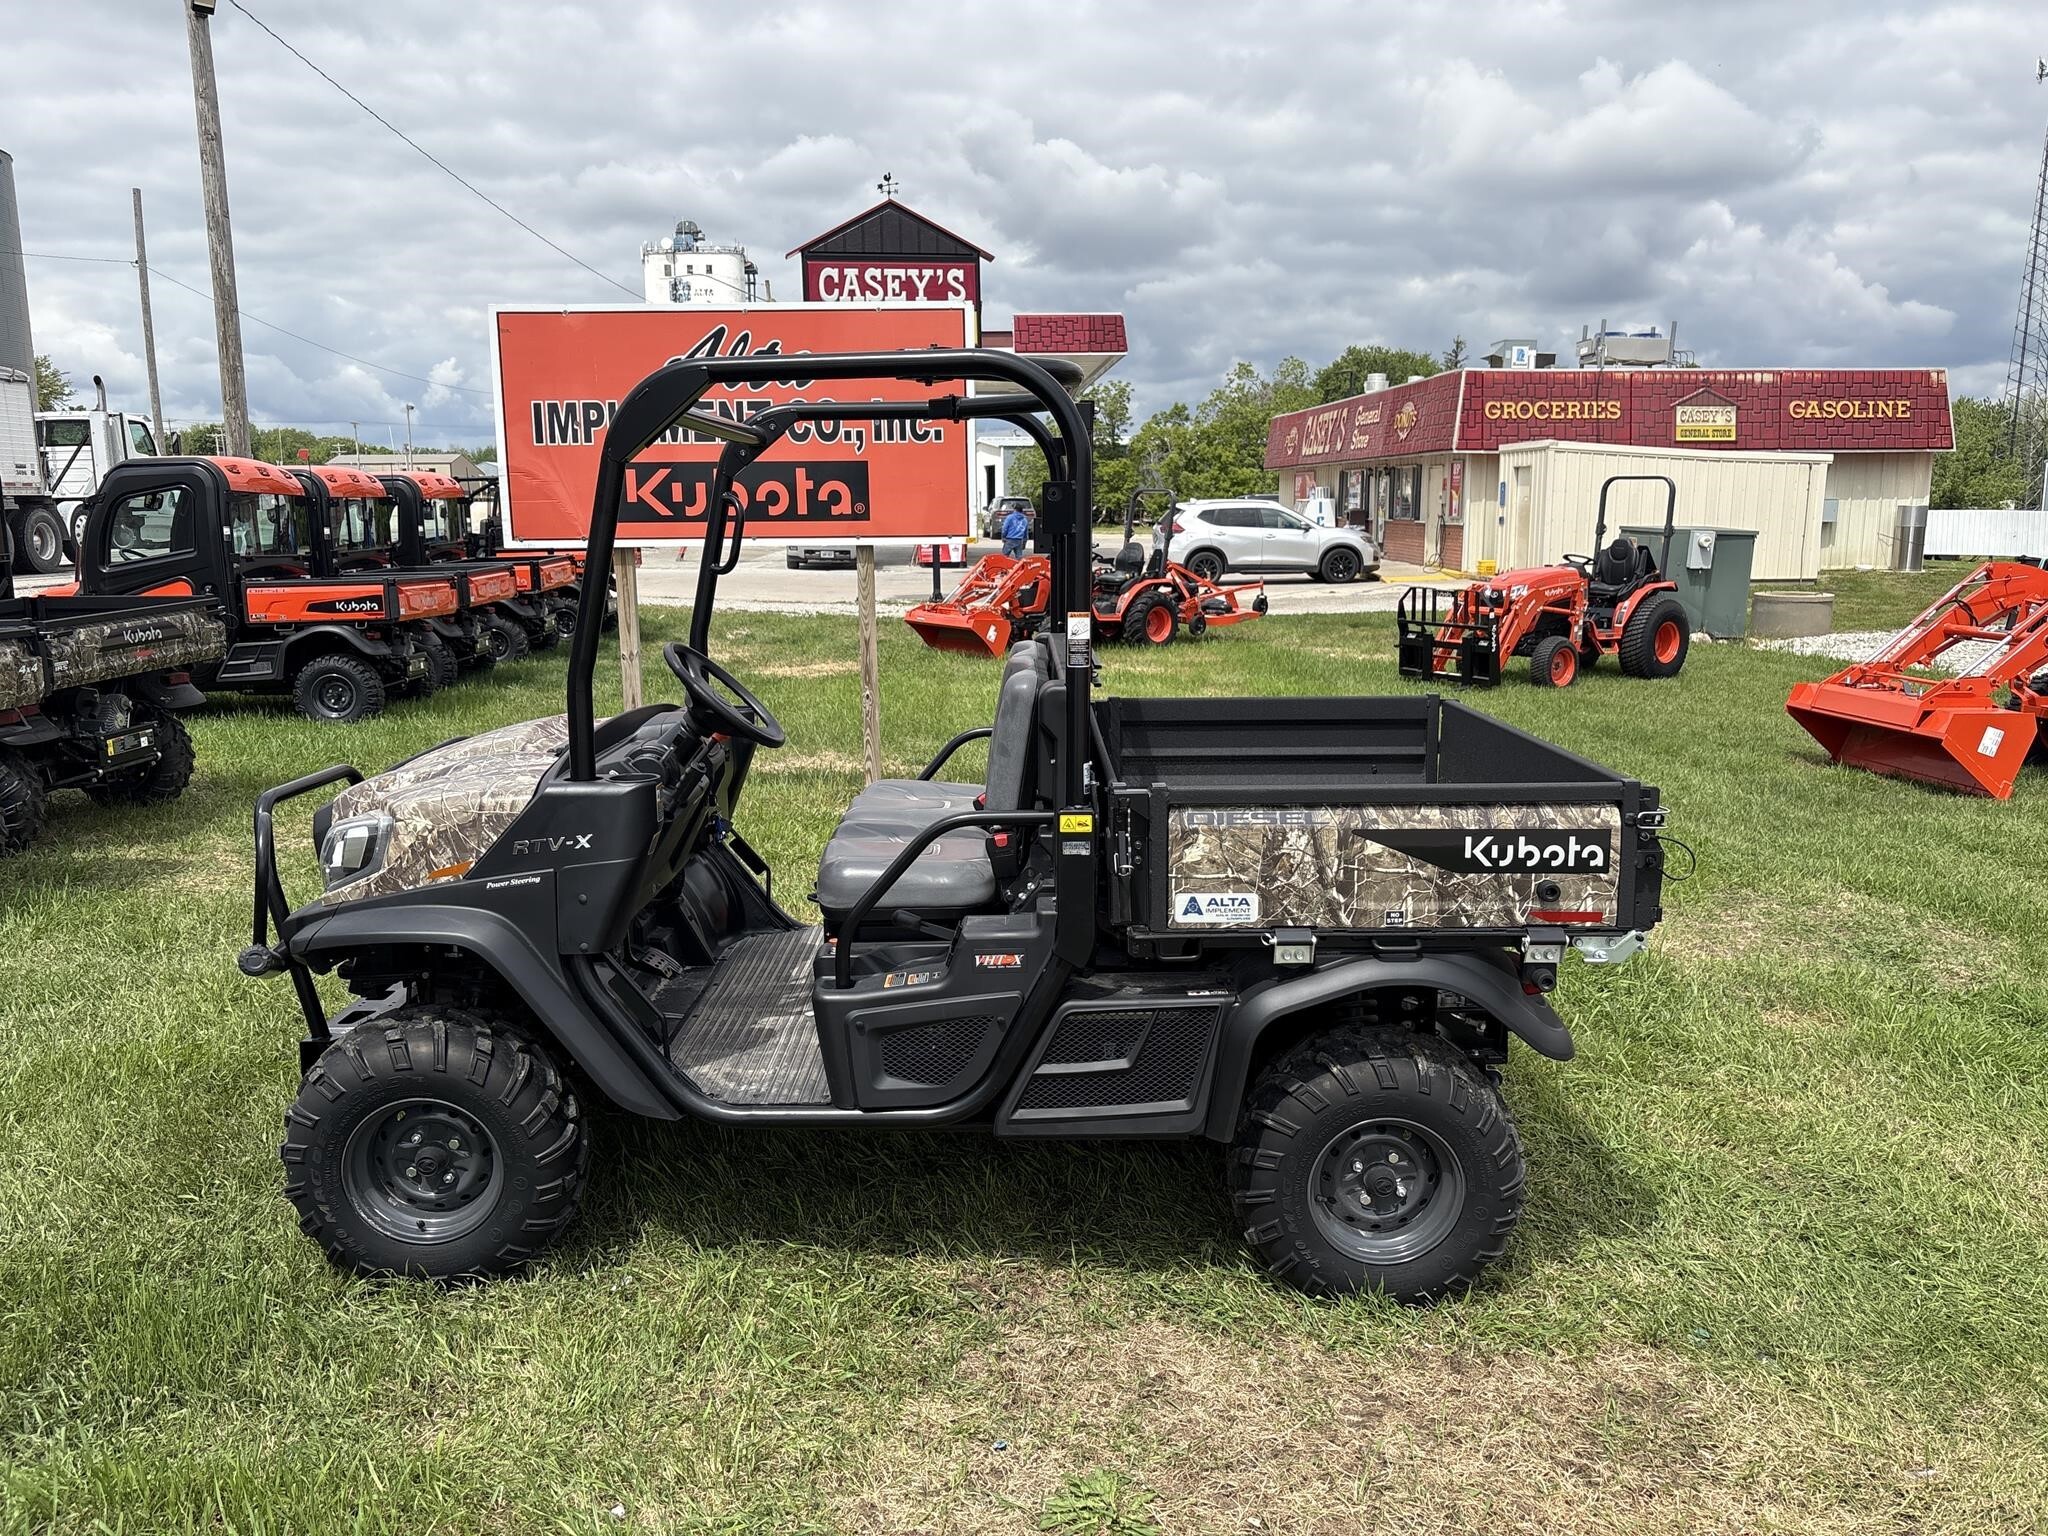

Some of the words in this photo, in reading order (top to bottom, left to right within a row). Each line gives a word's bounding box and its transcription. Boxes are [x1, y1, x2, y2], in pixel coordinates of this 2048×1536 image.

[818, 267, 967, 302] CASEY'S
[1484, 401, 1621, 419] GROCERIES
[1680, 410, 1733, 423] CASEY'S
[1789, 400, 1911, 418] GASOLINE
[1302, 408, 1349, 455] CASEY'S
[1680, 429, 1710, 438] GENERAL
[1712, 429, 1732, 438] STORE
[335, 601, 379, 611] Kubota
[123, 627, 163, 644] Kubota
[1187, 812, 1330, 826] DIESEL
[511, 833, 594, 856] RTV-X
[1464, 836, 1605, 867] Kubota
[486, 880, 510, 890] Power
[510, 876, 541, 887] Steering
[1207, 897, 1251, 907] ALTA
